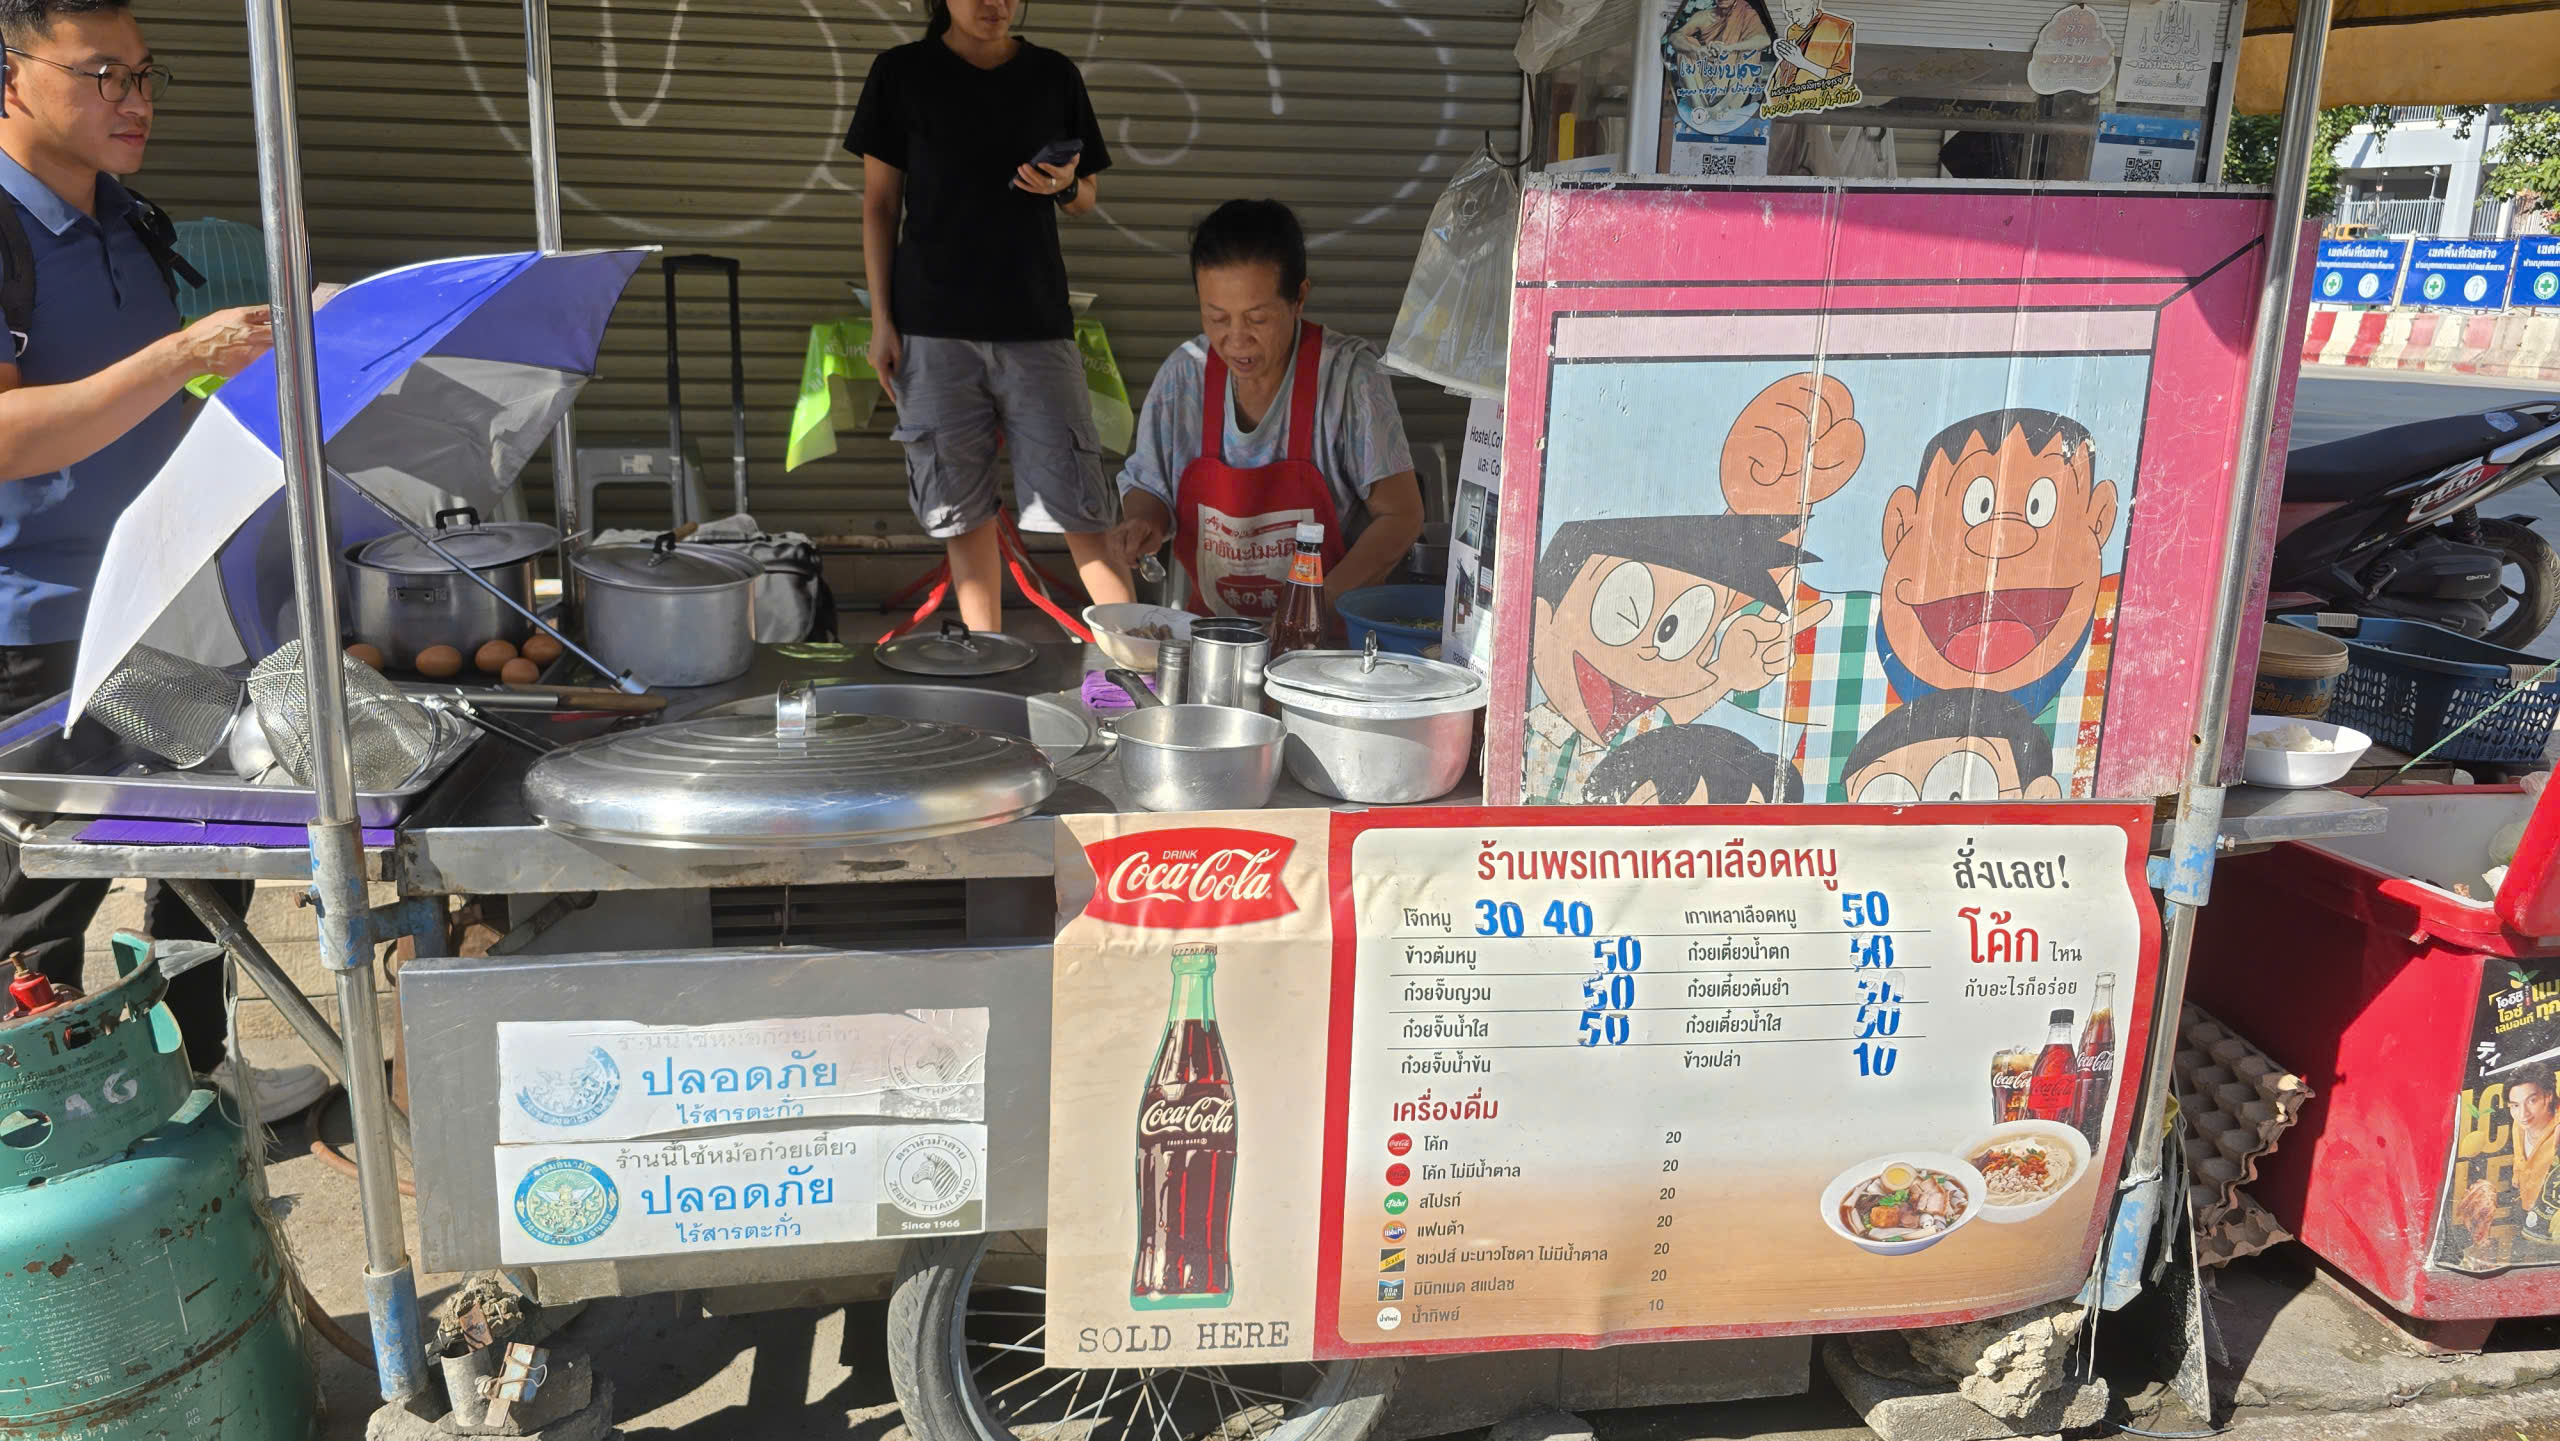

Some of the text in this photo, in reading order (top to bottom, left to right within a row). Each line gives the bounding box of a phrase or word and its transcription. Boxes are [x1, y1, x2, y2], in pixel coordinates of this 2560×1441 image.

[1162, 849, 1199, 860] DRINK
[1477, 838, 1839, 891] ร้านพรเกาเหลาเลือดหมู
[1953, 838, 2069, 890] สั่งเลย!
[1108, 848, 1280, 904] Coca-Cola
[1403, 907, 1452, 933] โจ๊กหมู
[1475, 899, 1594, 938] 30 40
[1684, 905, 1797, 929] เกาเหลาเลือดหมู
[1842, 891, 1890, 928] 50
[1958, 907, 2083, 963] โค้ก ไหน
[1405, 945, 1477, 971] ข้าวต้มหมู
[1593, 936, 1642, 974] 50
[1687, 936, 1790, 962] ก๋วยเตี๋ยวน้ำตก
[1404, 978, 1491, 1005] ก๋วยจั๊บญวน
[1582, 974, 1635, 1011] 50
[1687, 973, 1789, 998] ก๋วยเตี๋ยวต้มยำ
[1964, 976, 2078, 998] กับอะไรก็อร่อย
[1403, 1014, 1488, 1038] ก๋วยจั๊บน้ำใส
[1578, 1011, 1630, 1047] 50
[1686, 1009, 1782, 1034] ก๋วยเตี๋ยวน้ำใส
[2495, 1012, 2534, 1034] เลมอนที
[1401, 1050, 1491, 1074] ก๋วยจั๊บน้ำข้น
[1683, 1050, 1741, 1069] ข้าวเปล่า
[1853, 1041, 1898, 1077] 10
[642, 1050, 837, 1096] ปลอดภัย
[676, 1094, 804, 1124] ไร้สารตะกั่ว
[1140, 1096, 1235, 1136] Coca-Cola
[1393, 1087, 1499, 1122] เครื่องดื่ม
[616, 1131, 857, 1169] ร้านนี้ใช้หม้อก๋วยเตี๋ยว
[1424, 1136, 1448, 1151] โค้ก
[1666, 1131, 1682, 1145] 20
[1422, 1164, 1446, 1180] โค้ก
[1451, 1159, 1521, 1179] ไม่มีน้ำตาล
[1662, 1159, 1679, 1173] 20
[641, 1164, 833, 1215] ปลอดภัย
[889, 1178, 972, 1213] ZEBRA THAILAND
[1419, 1192, 1462, 1209] สไปรท์
[1659, 1187, 1676, 1200] 20
[675, 1212, 801, 1243] ไร้สารตะกั่ว
[901, 1219, 960, 1231] Since 1966
[1417, 1220, 1465, 1237] แฟนต้า
[1656, 1215, 1673, 1228] 20
[1416, 1249, 1457, 1265] ชเวปส์
[1461, 1246, 1534, 1263] มะนาวโซดา
[1539, 1243, 1608, 1262] ไม่มีน้ำตาล
[1654, 1242, 1670, 1256] 20
[1413, 1280, 1466, 1297] มินิทเมด
[1651, 1269, 1667, 1283] 20
[1412, 1306, 1461, 1323] น้ำทิพย์
[1649, 1298, 1664, 1311] 10
[1078, 1321, 1290, 1353] SOLD HERE
[187, 1416, 201, 1428] KG
